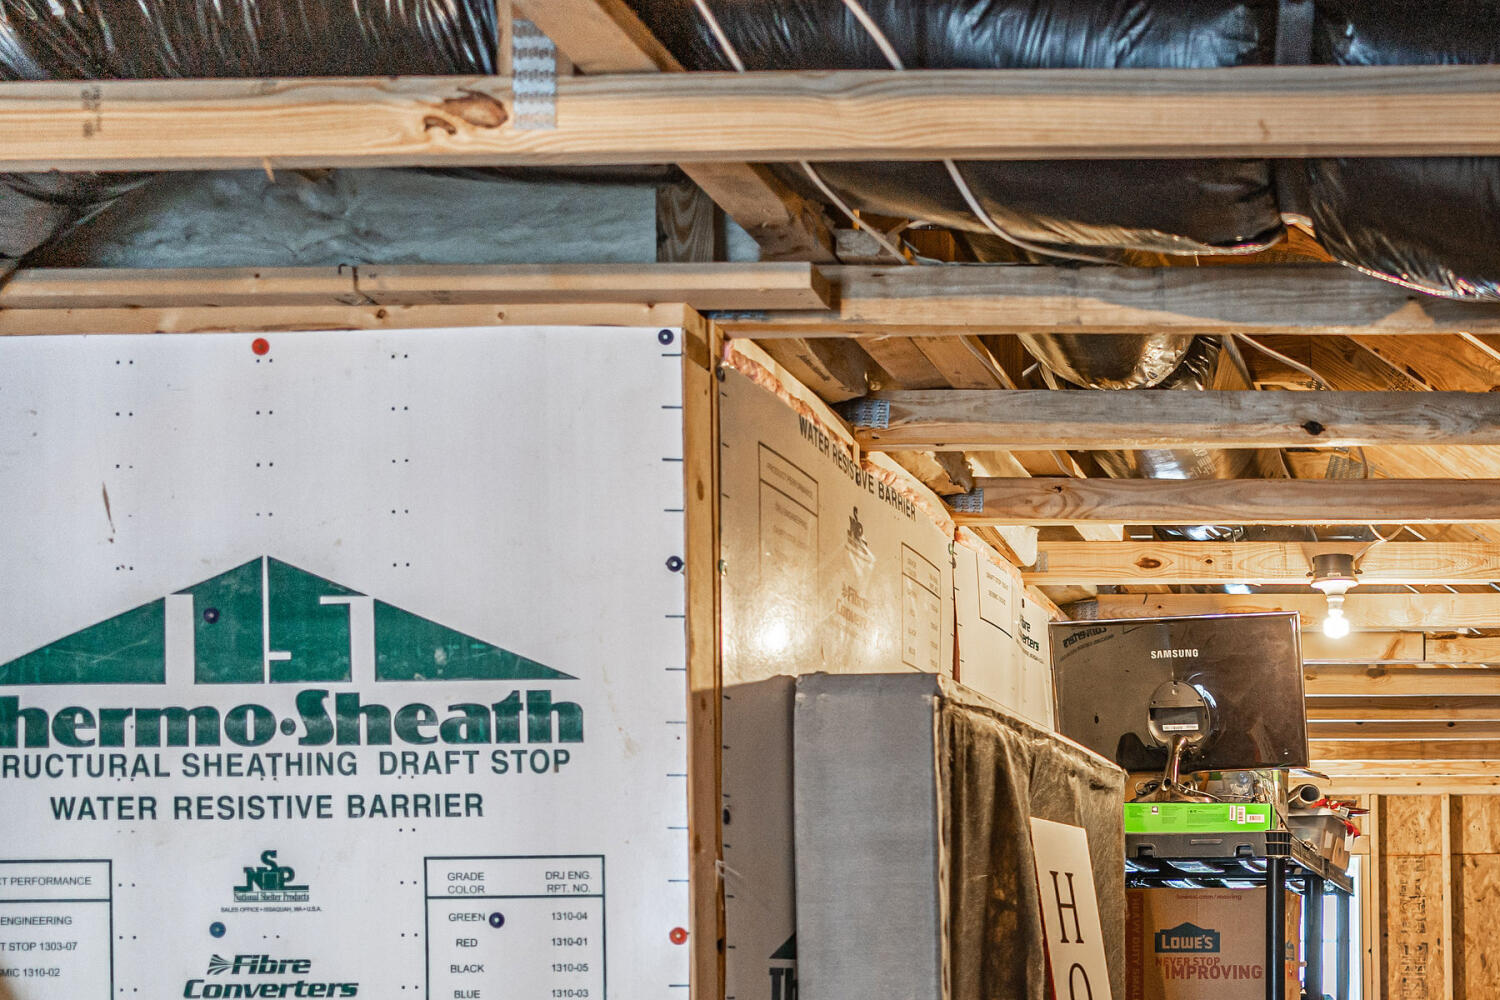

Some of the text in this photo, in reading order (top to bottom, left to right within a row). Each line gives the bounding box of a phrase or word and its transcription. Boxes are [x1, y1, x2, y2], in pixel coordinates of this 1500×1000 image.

[798, 414, 829, 459] WATER
[878, 477, 916, 521] BARRIER
[1150, 648, 1199, 659] SAMSUNG
[182, 751, 358, 777] SHEATHING
[379, 750, 480, 776] DRAFT
[491, 749, 571, 774] STOP
[50, 793, 484, 821] WATER RESISTIVE BARRIER
[447, 872, 485, 881] GRADE
[545, 871, 565, 880] DRJ
[10, 876, 92, 886] PERFORMANCE
[447, 885, 485, 894] COLOR
[547, 884, 590, 893] RPT. NO.
[0, 916, 72, 925] ENGINEERING
[448, 913, 485, 922] GREEN
[551, 912, 588, 920] 1310-04
[8, 942, 36, 951] STOP
[40, 941, 78, 951] 1303-07
[456, 938, 478, 947] RED
[551, 938, 588, 946] 1310-01
[231, 954, 311, 975] Fibre
[1155, 956, 1221, 967] NEVER STOP
[23, 967, 61, 977] 1310-02
[450, 964, 485, 973] BLACK
[551, 963, 589, 972] 1310-05
[1165, 964, 1264, 980] IMPROVING
[183, 979, 359, 999] Converters
[551, 989, 589, 998] 1310-03
[453, 990, 481, 999] BLUE
